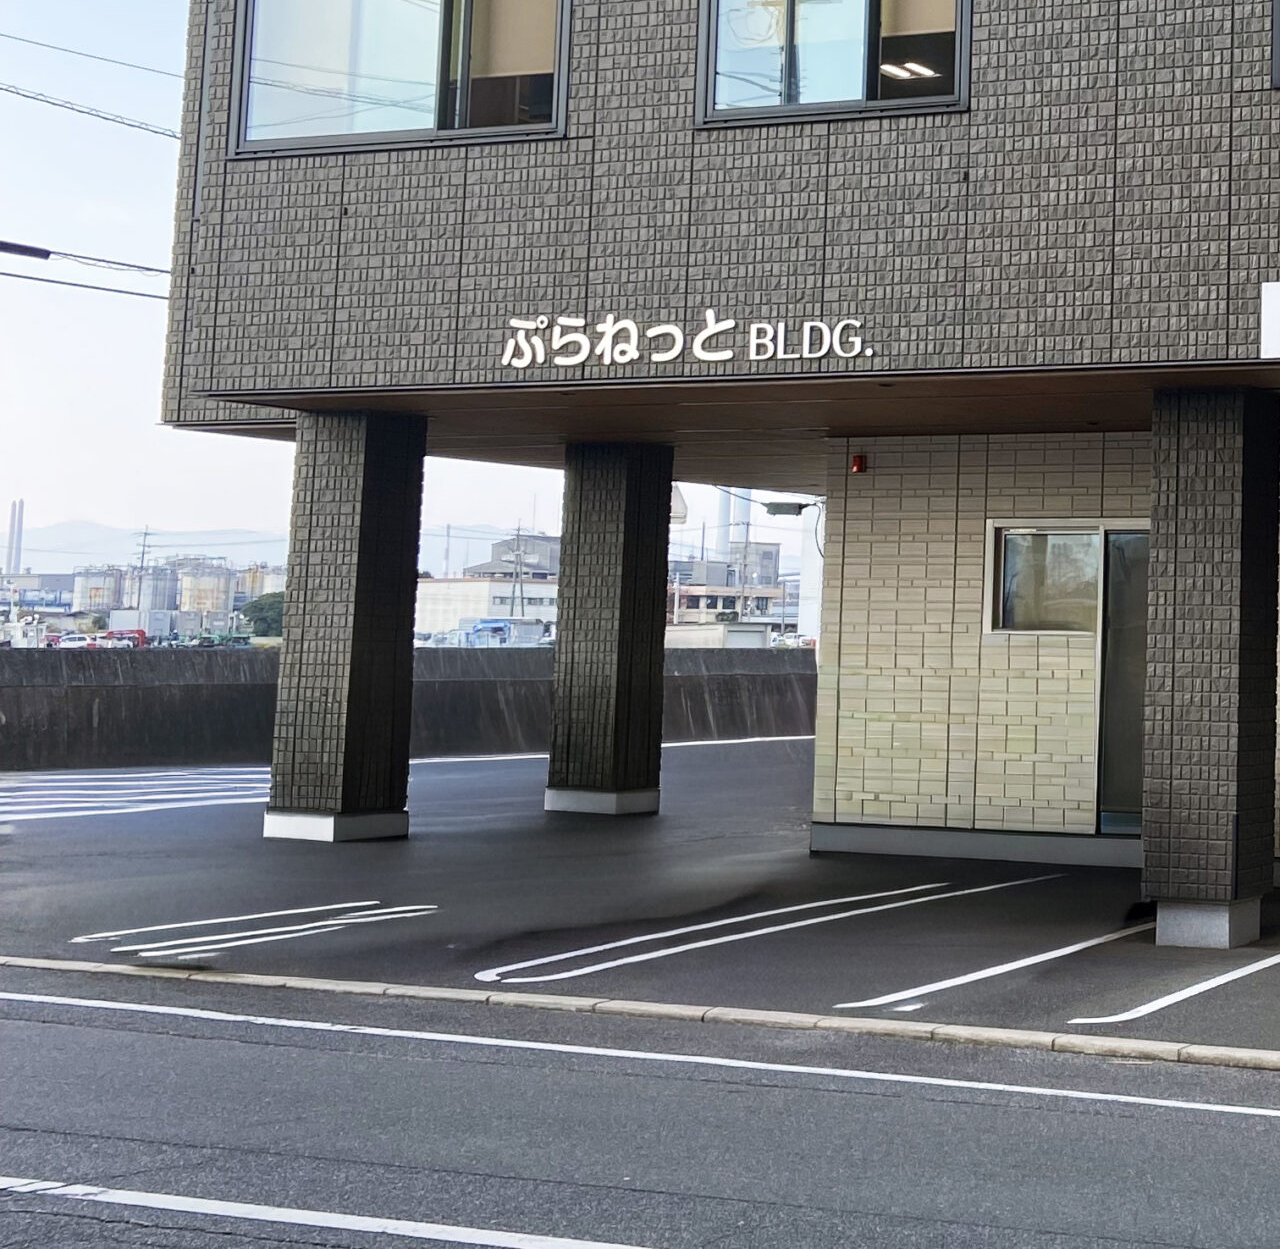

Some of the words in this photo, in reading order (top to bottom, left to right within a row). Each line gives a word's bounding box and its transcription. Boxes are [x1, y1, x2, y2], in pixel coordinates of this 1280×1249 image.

[501, 308, 736, 369] ぷらねっと
[749, 319, 874, 361] BLDG.
